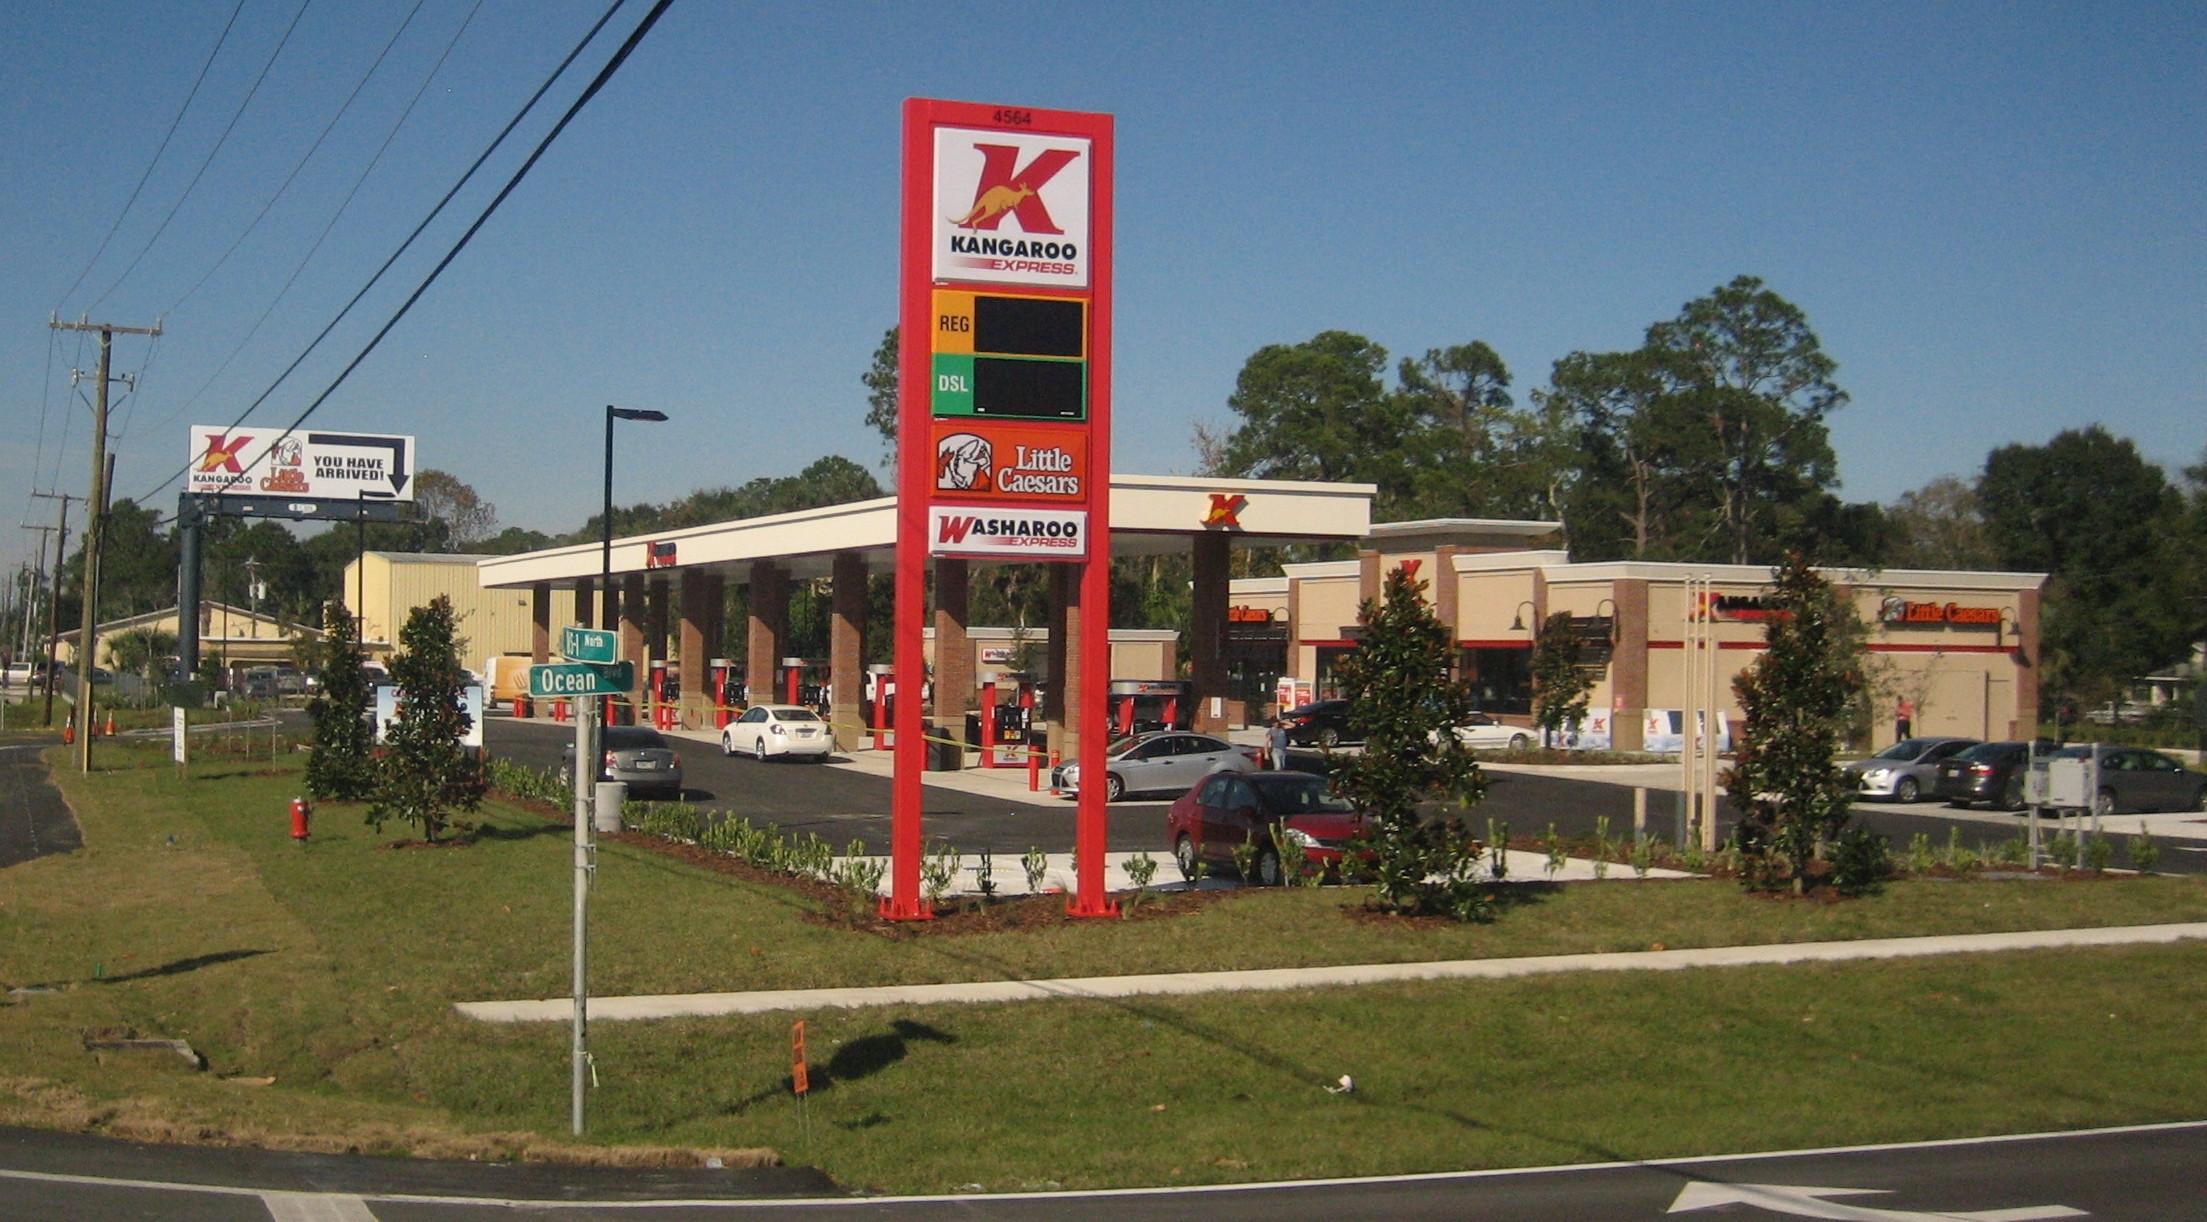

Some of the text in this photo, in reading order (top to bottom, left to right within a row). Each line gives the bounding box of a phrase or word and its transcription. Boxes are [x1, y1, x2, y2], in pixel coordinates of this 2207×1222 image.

[992, 110, 1032, 125] 4564
[951, 235, 1077, 260] KANGAROO
[991, 259, 1075, 275] EXPRESS
[940, 315, 970, 332] REG
[938, 375, 969, 392] DSL
[313, 455, 384, 470] YOU HAVE
[1015, 445, 1072, 472] Little
[315, 467, 385, 481] ARRIVED!
[998, 467, 1079, 495] Caesars
[938, 515, 1078, 545] WASHAROO
[1009, 536, 1077, 548] EXPRESS
[584, 634, 603, 647] North
[541, 668, 596, 692] Ocean
